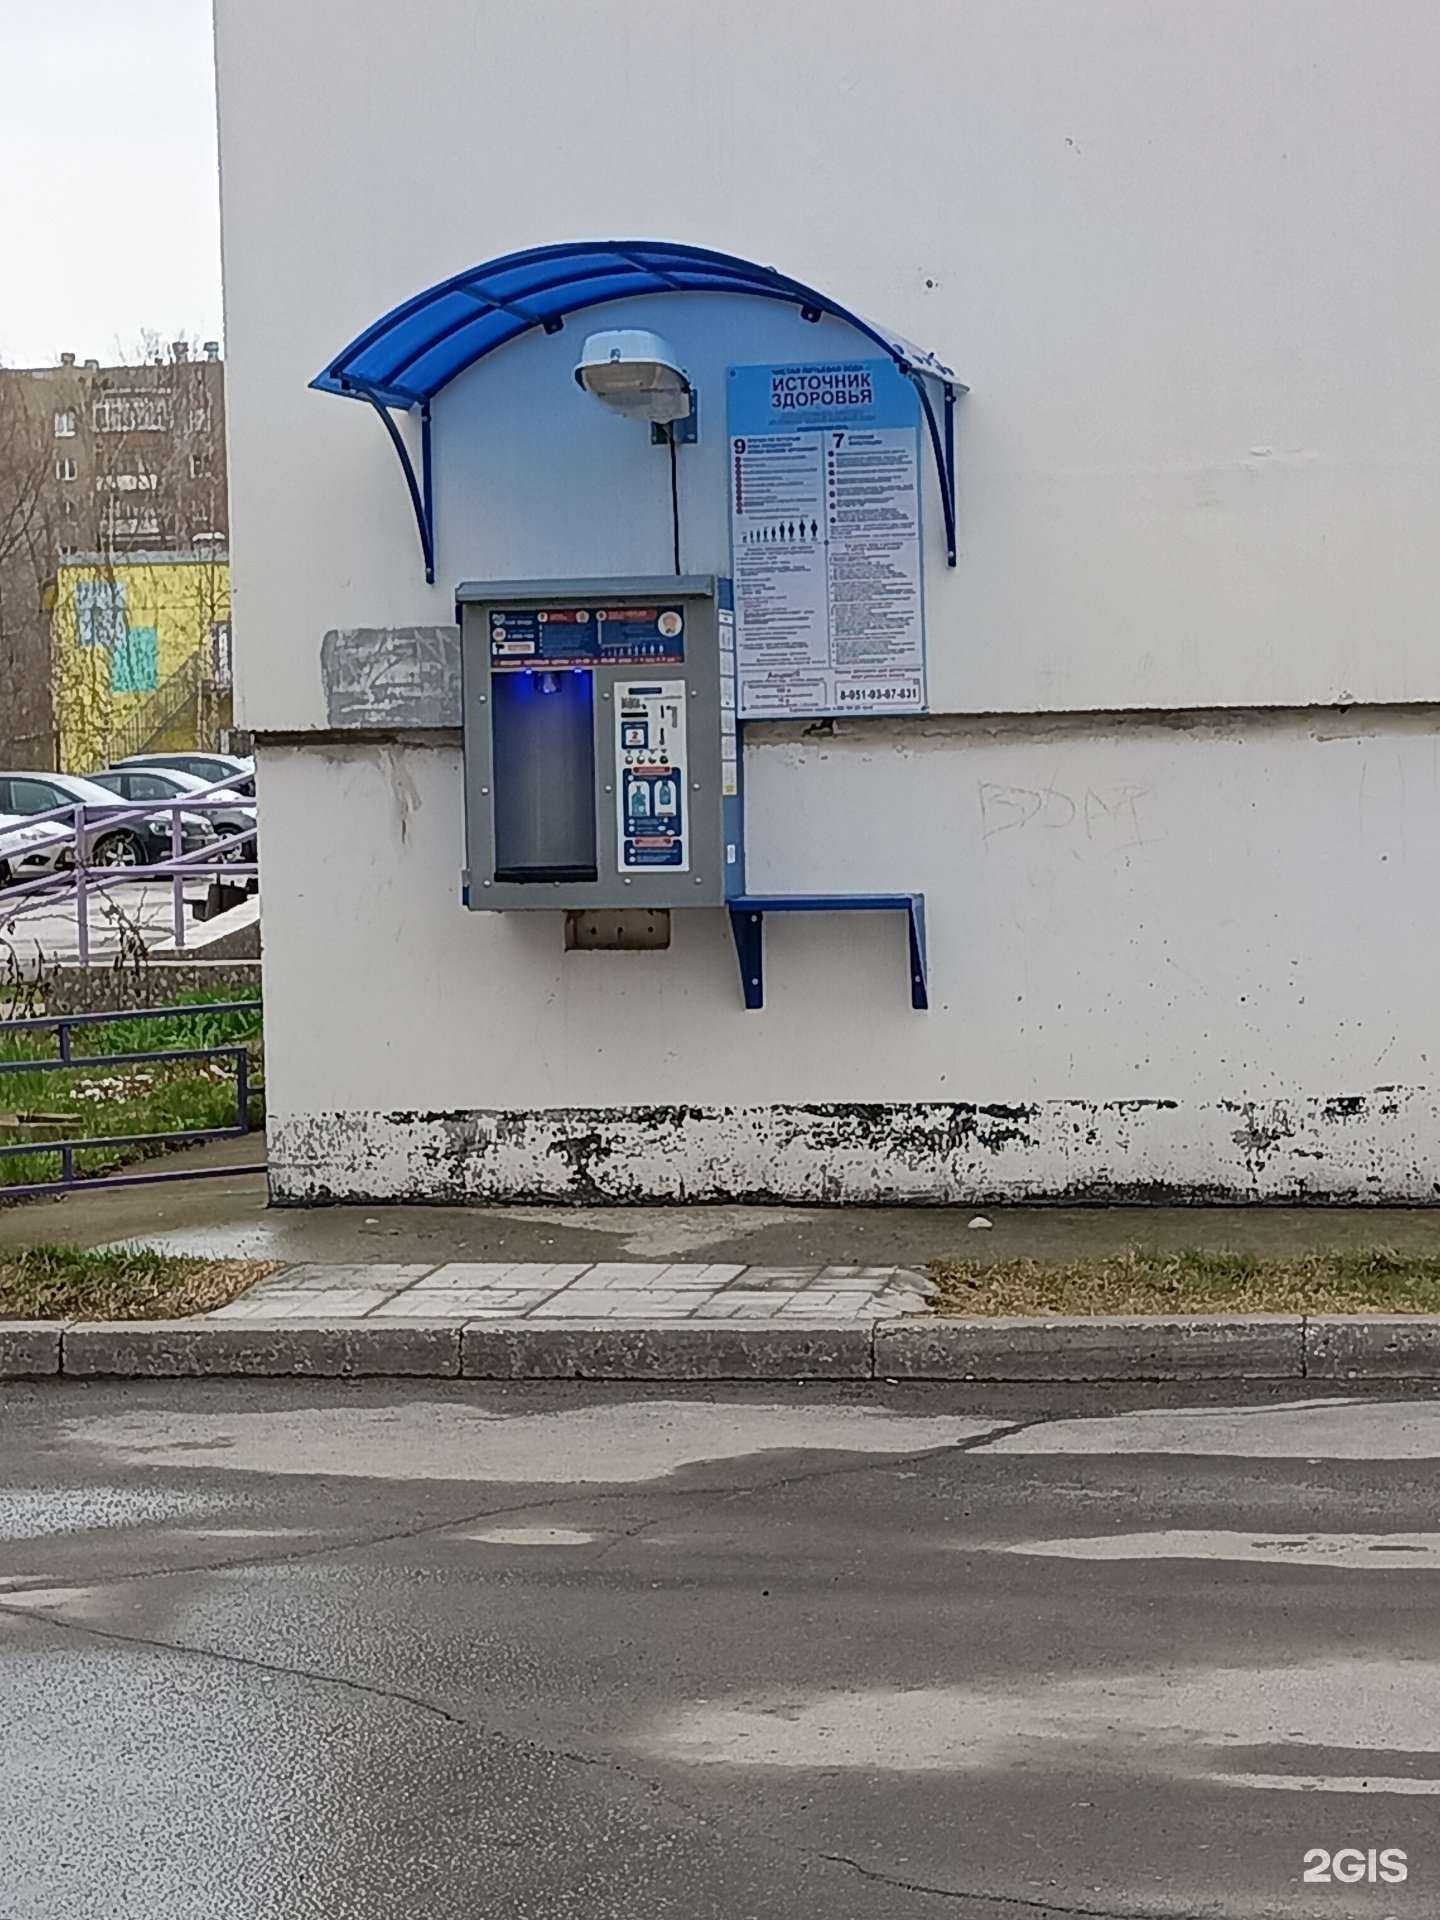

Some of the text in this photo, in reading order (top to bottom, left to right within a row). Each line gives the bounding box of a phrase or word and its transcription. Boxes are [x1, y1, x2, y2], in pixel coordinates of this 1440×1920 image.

[772, 373, 871, 392] ИСТОЧНИК
[771, 389, 872, 409] ЗДОРОВЬЯ
[733, 438, 746, 455] 9
[832, 433, 845, 449] 7
